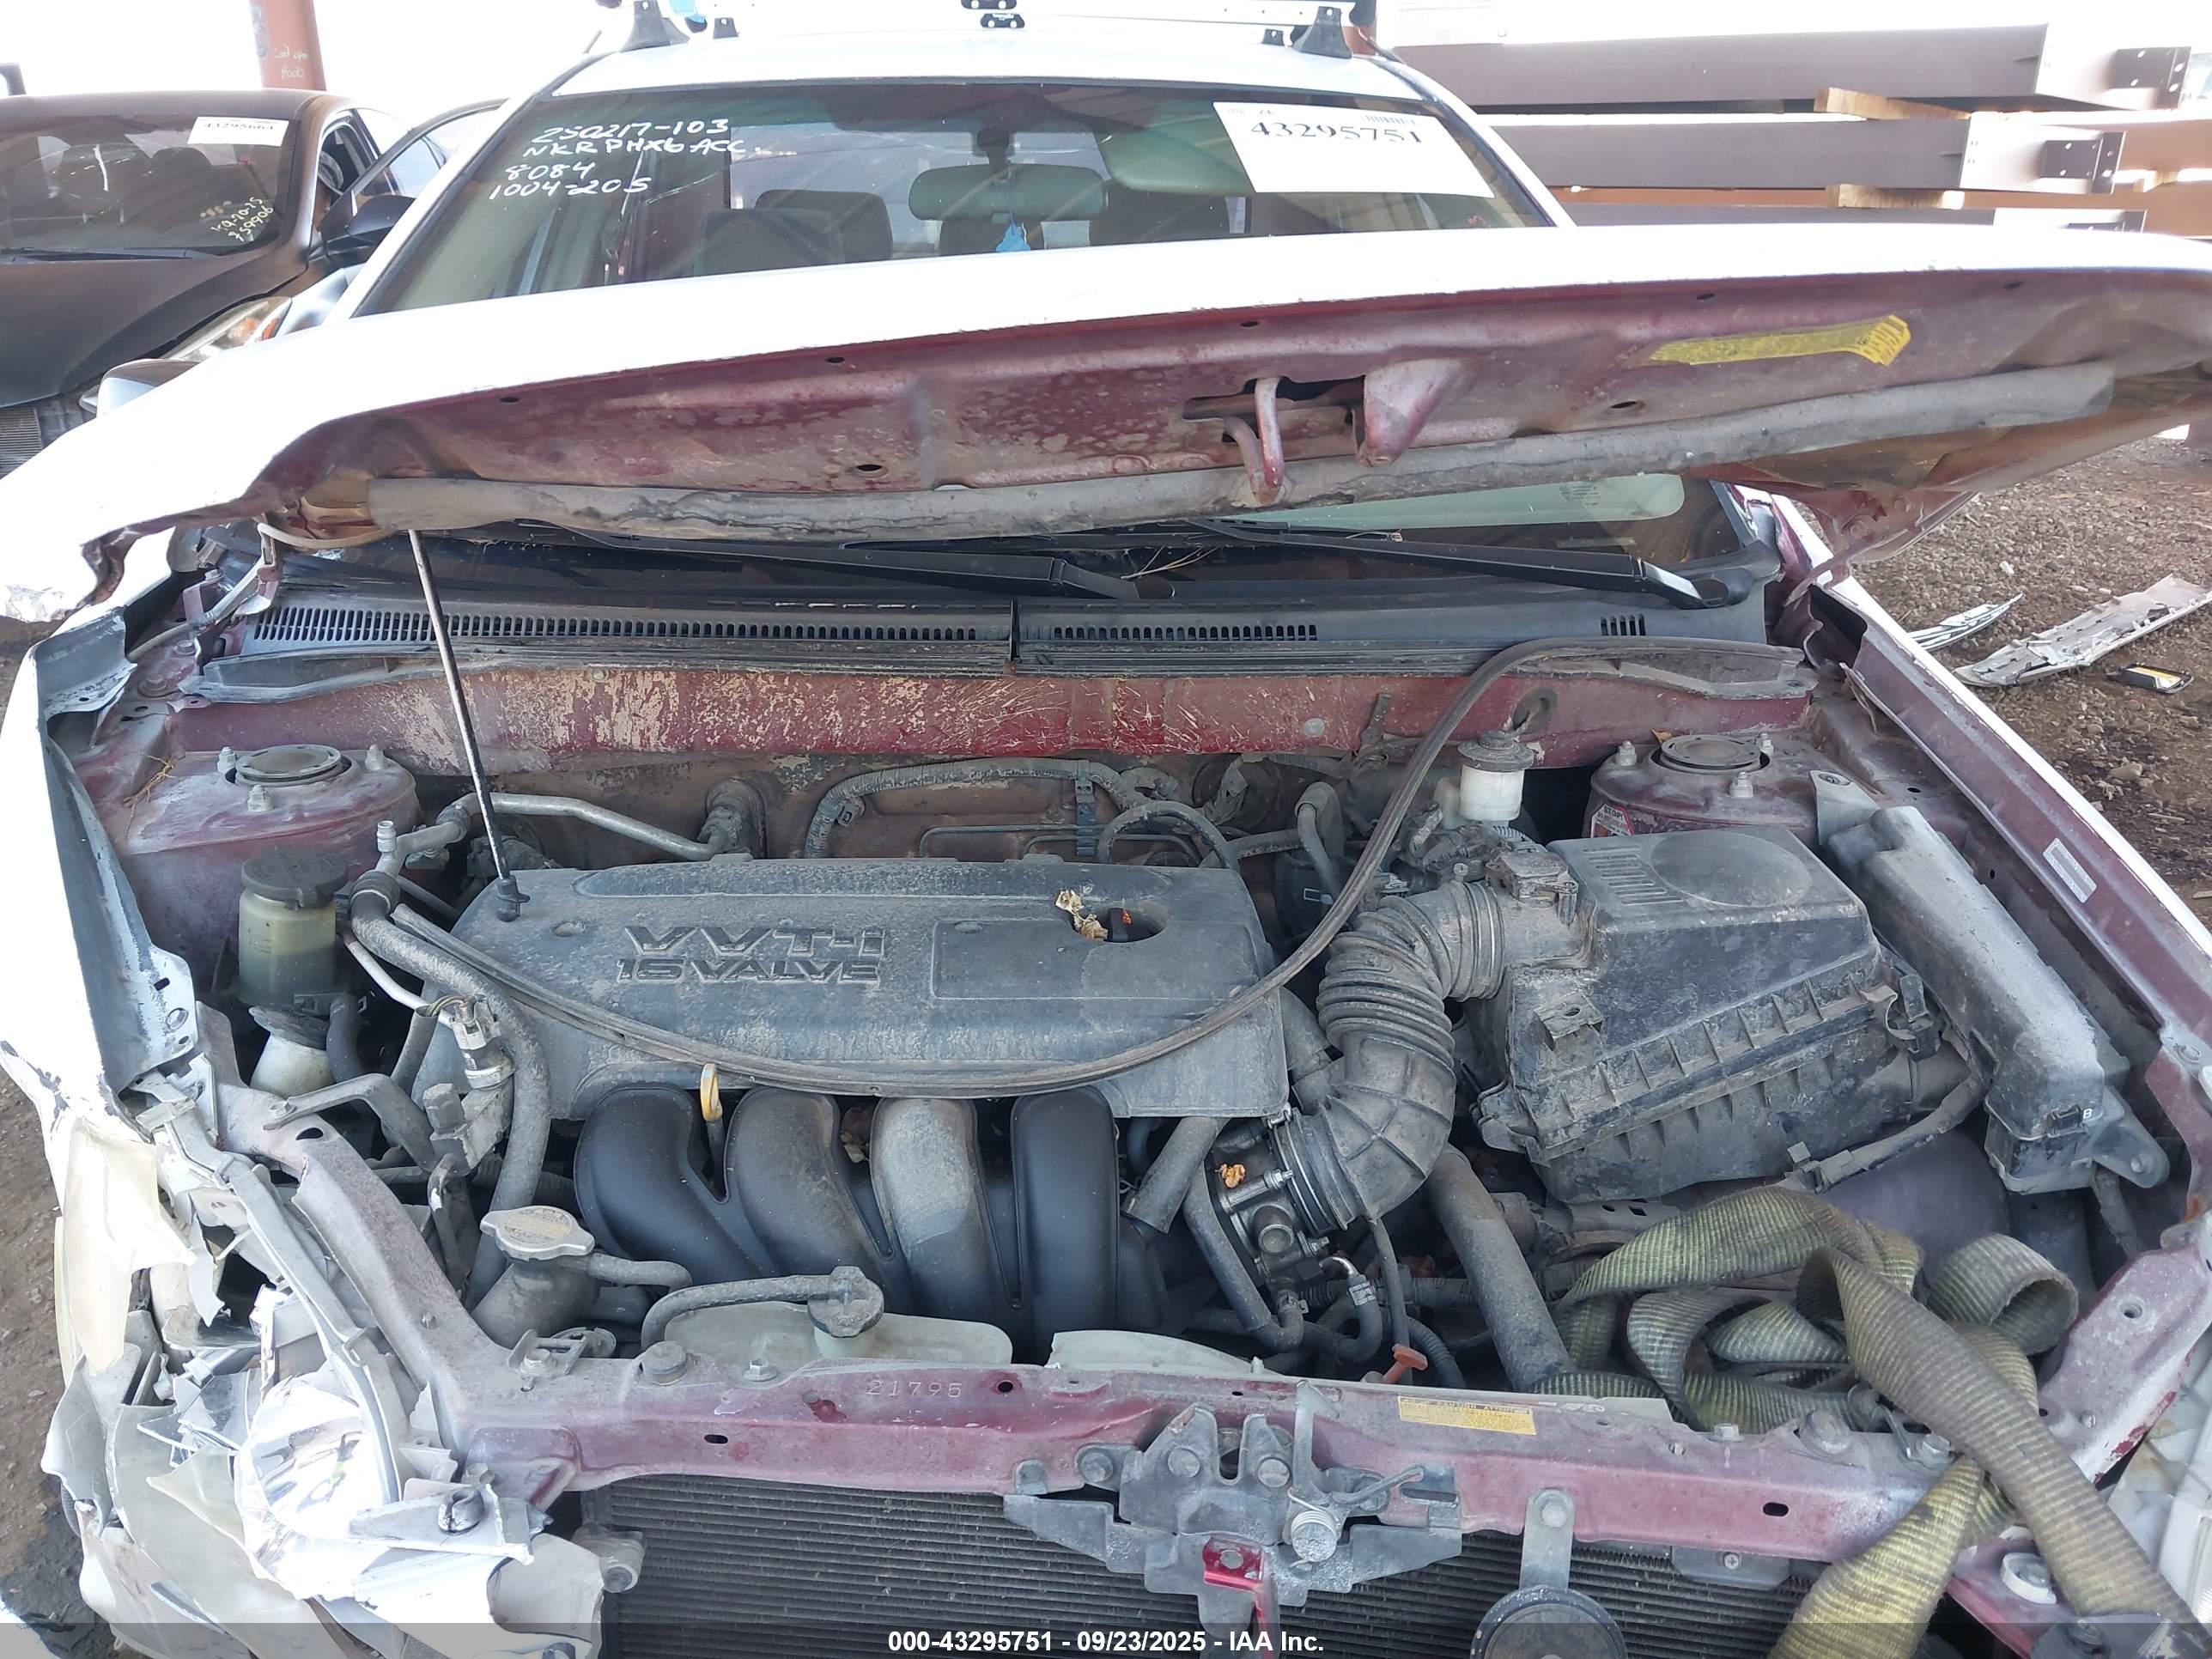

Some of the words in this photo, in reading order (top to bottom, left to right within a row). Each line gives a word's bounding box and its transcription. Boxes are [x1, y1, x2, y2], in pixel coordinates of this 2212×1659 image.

[1250, 121, 1422, 143] 43295751
[522, 140, 599, 158] NKR
[504, 161, 596, 181] 8084
[488, 176, 653, 200] 1004-205
[617, 957, 686, 983] 16
[690, 958, 880, 986] VALVE
[865, 1379, 963, 1398] 21795
